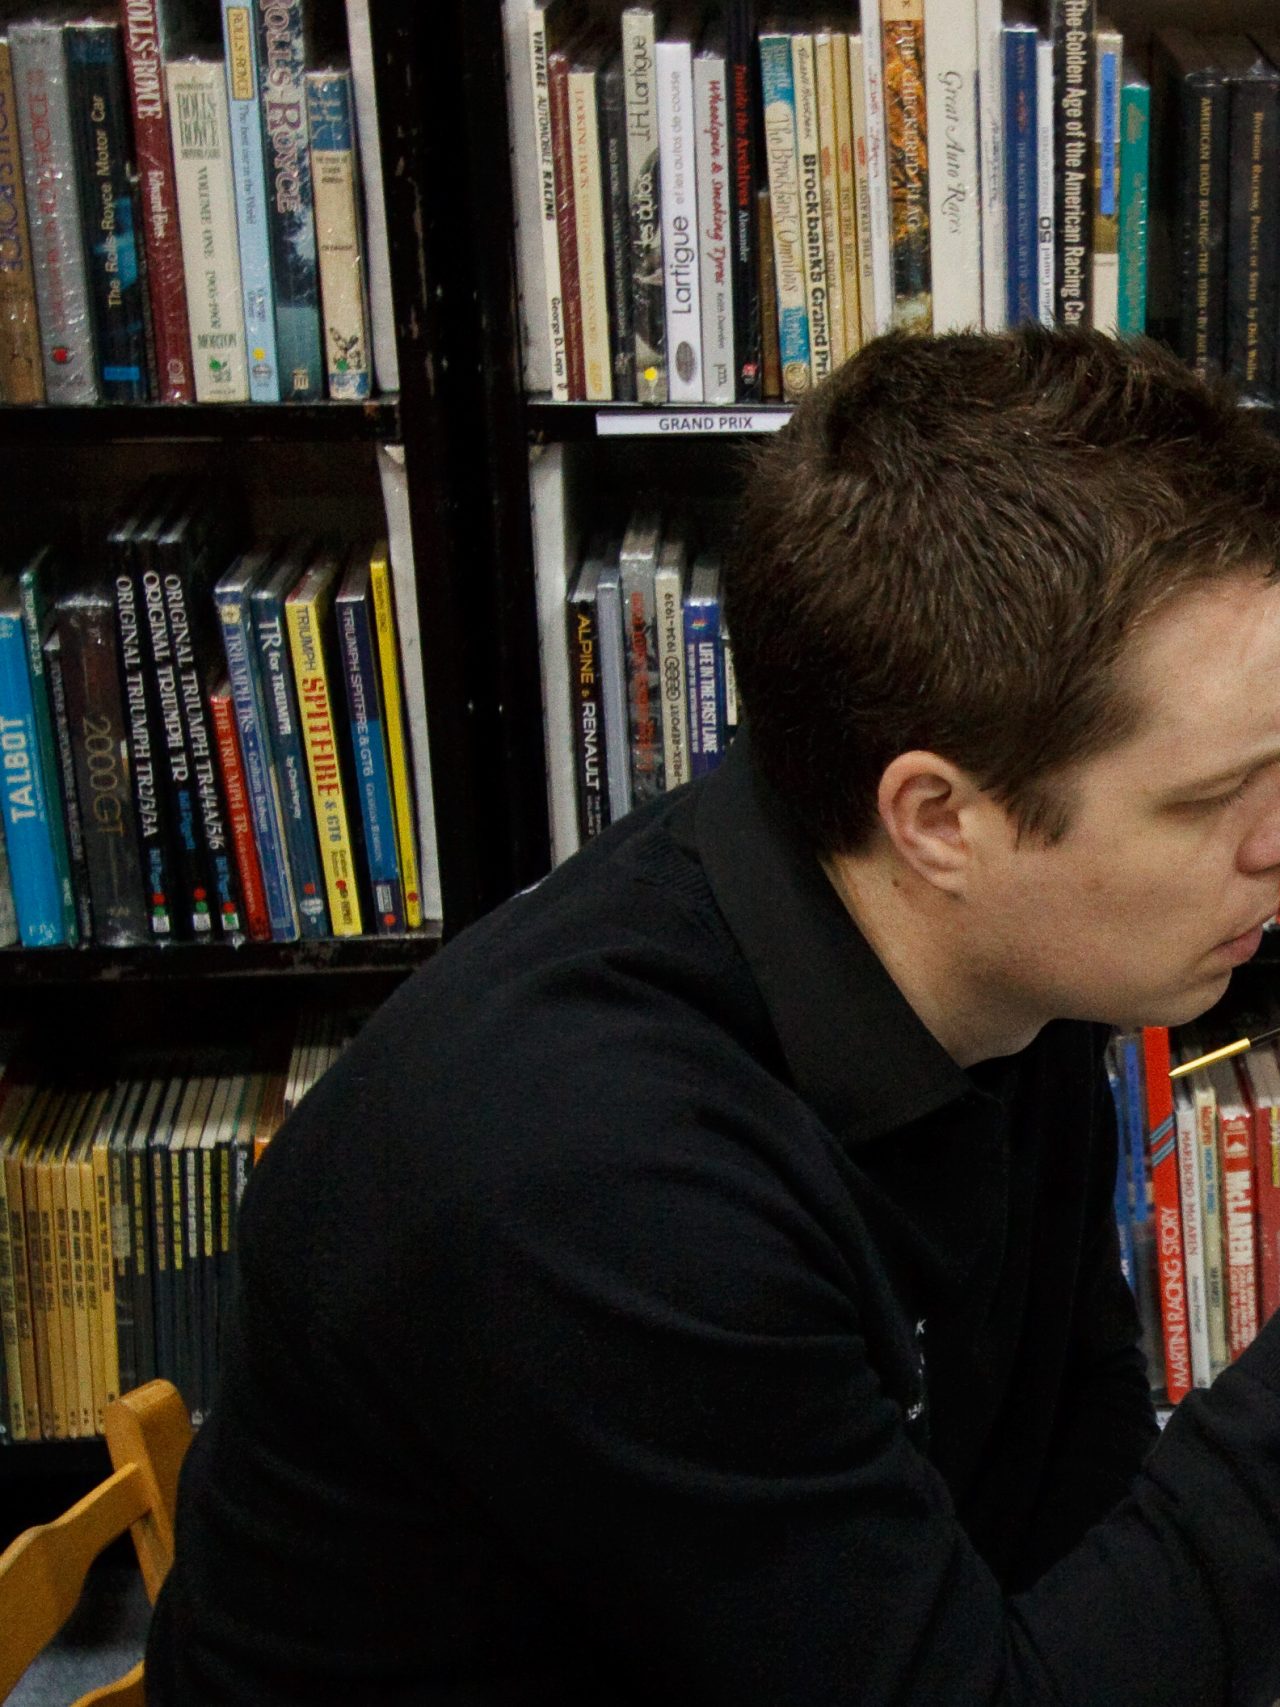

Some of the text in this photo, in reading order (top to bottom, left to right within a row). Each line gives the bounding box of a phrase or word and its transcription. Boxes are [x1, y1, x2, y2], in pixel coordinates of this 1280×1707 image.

[623, 34, 655, 105] Lartigue
[669, 69, 680, 110] course
[1064, 31, 1085, 82] Golden
[532, 31, 555, 220] VINTAGE AUTOMOBILE RACING
[671, 114, 681, 130] de
[701, 80, 723, 156] Wheelspin
[769, 112, 794, 143] The
[899, 68, 919, 174] CHECKERED
[937, 70, 964, 122] Great
[1064, 87, 1085, 117] Age
[1064, 121, 1085, 137] of
[672, 135, 683, 168] autos
[735, 138, 750, 206] Archives
[945, 126, 966, 177] Auto
[1064, 142, 1085, 166] the
[1198, 97, 1212, 195] AMERICAN ROAD
[84, 94, 127, 306] The Rolls-Royce Motor Car
[196, 166, 215, 257] VOLUME ONE
[1064, 171, 1085, 241] American
[667, 215, 697, 314] Lartigue
[708, 246, 728, 284] Tyres
[776, 229, 802, 292] Omnibus
[802, 153, 827, 346] Brockbank's Grand
[1064, 246, 1085, 296] Racing
[550, 296, 563, 335] George
[659, 416, 753, 430] GRAND PRIX
[296, 606, 316, 671] TRIUMPH
[663, 592, 676, 652] 1934-1939
[112, 574, 159, 837] ORIGINAL TRIUMPH TR2/3/3A
[141, 569, 188, 781] ORIGINAL TRIUMPH TR
[227, 633, 256, 733] TRIUMPH TRs
[257, 616, 291, 735] TR for TRIUMPH
[339, 609, 373, 776] TRIUMPH SPITFIRE & GT6
[578, 613, 597, 790] ALPINE RENAULT
[695, 642, 720, 753] LIFE IN THE FAST LANE
[163, 572, 230, 849] ORIGINAL TRIUMPH TR4/4A/5/6
[213, 703, 230, 731] THE
[300, 675, 339, 795] SPITFIRE
[0, 716, 35, 823] TALBOT
[324, 798, 336, 808] &
[1180, 1131, 1193, 1196] MARLBORO
[1225, 1171, 1253, 1266] McLAREN
[1159, 1205, 1185, 1320] RACING STORY
